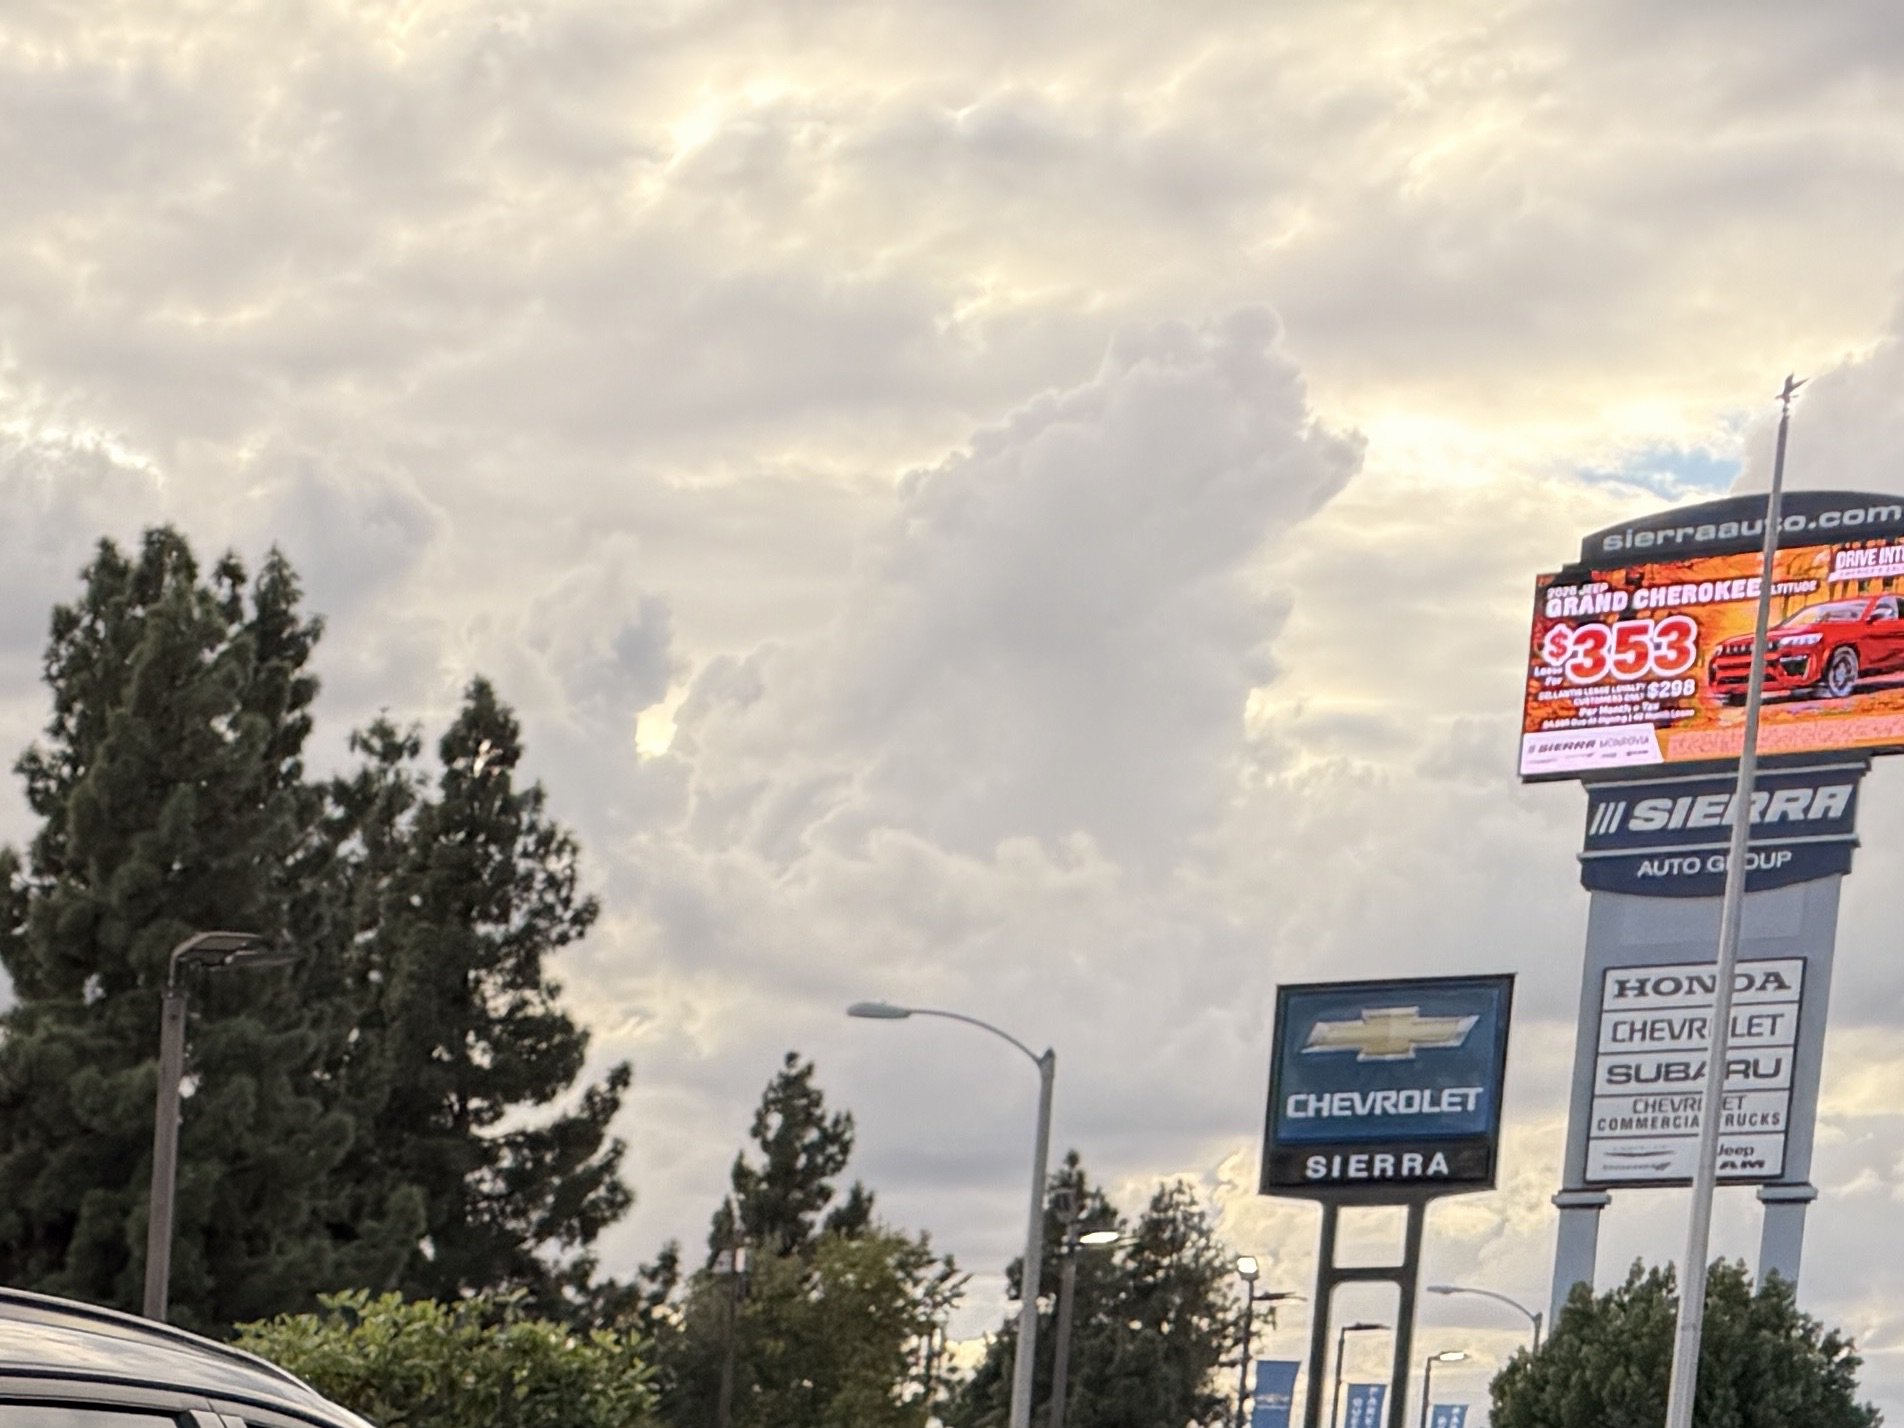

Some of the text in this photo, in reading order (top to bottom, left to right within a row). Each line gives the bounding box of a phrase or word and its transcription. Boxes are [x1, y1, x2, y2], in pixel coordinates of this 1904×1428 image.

[1835, 544, 1904, 570] DRIVE INT
[1545, 576, 1817, 618] GRAND CHEROKEE LTITUDE
[1543, 614, 1697, 684] $353
[1628, 784, 1854, 831] SIERRA
[1637, 850, 1792, 878] AUTO GOUP
[1613, 971, 1792, 999] HONDA
[1611, 1013, 1785, 1043] CHEVRLET
[1286, 1086, 1484, 1118] CHEVROLET
[1632, 1094, 1747, 1114] CHEVRET
[1597, 1111, 1781, 1132] COMMERCIA RUCKS
[1718, 1144, 1755, 1157] Jeep
[1305, 1151, 1449, 1179] SIERRA
[1719, 1160, 1765, 1170] AM
